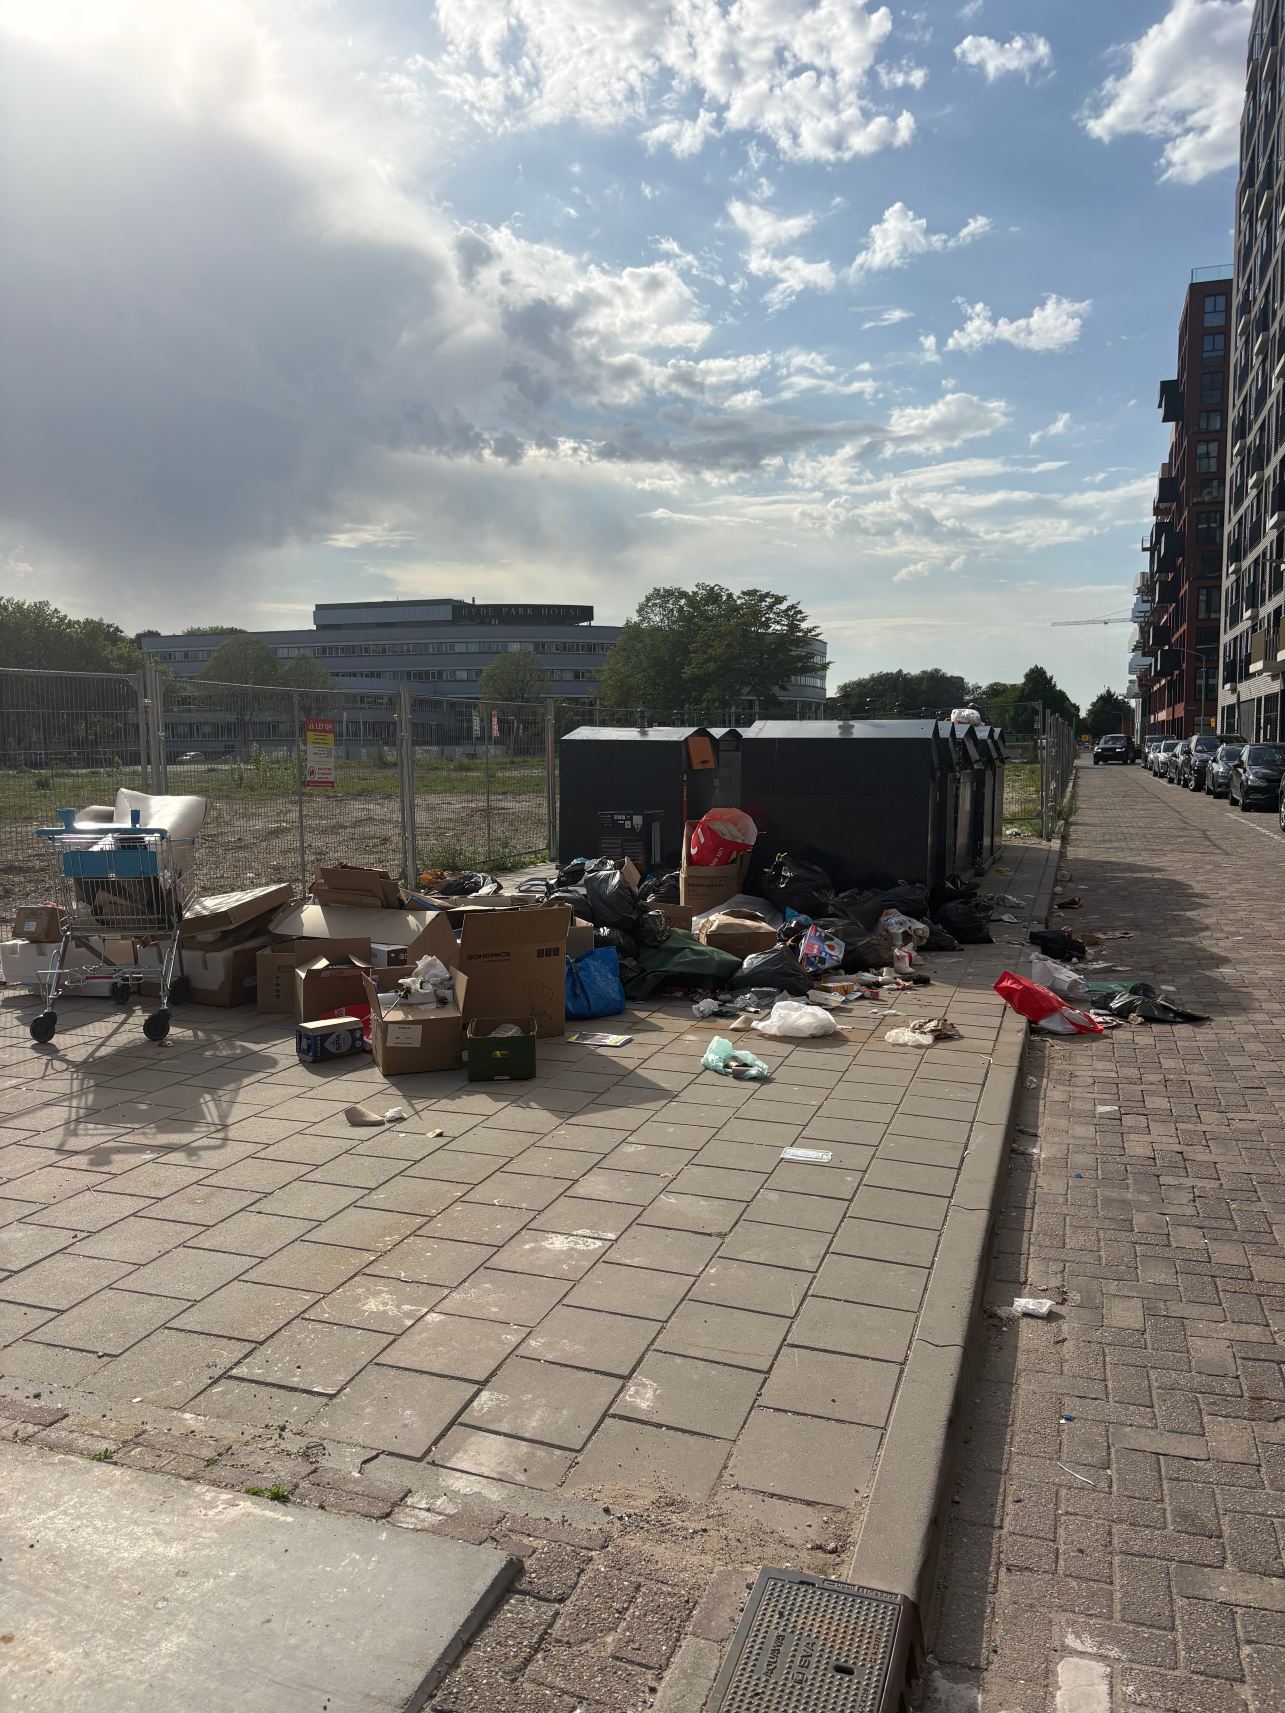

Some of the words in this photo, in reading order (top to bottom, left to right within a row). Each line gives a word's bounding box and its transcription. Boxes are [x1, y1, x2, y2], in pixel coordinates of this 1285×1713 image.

[462, 607, 495, 616] HYDE
[502, 607, 533, 616] PARK
[541, 607, 583, 617] HOUSE
[315, 722, 324, 730] LET
